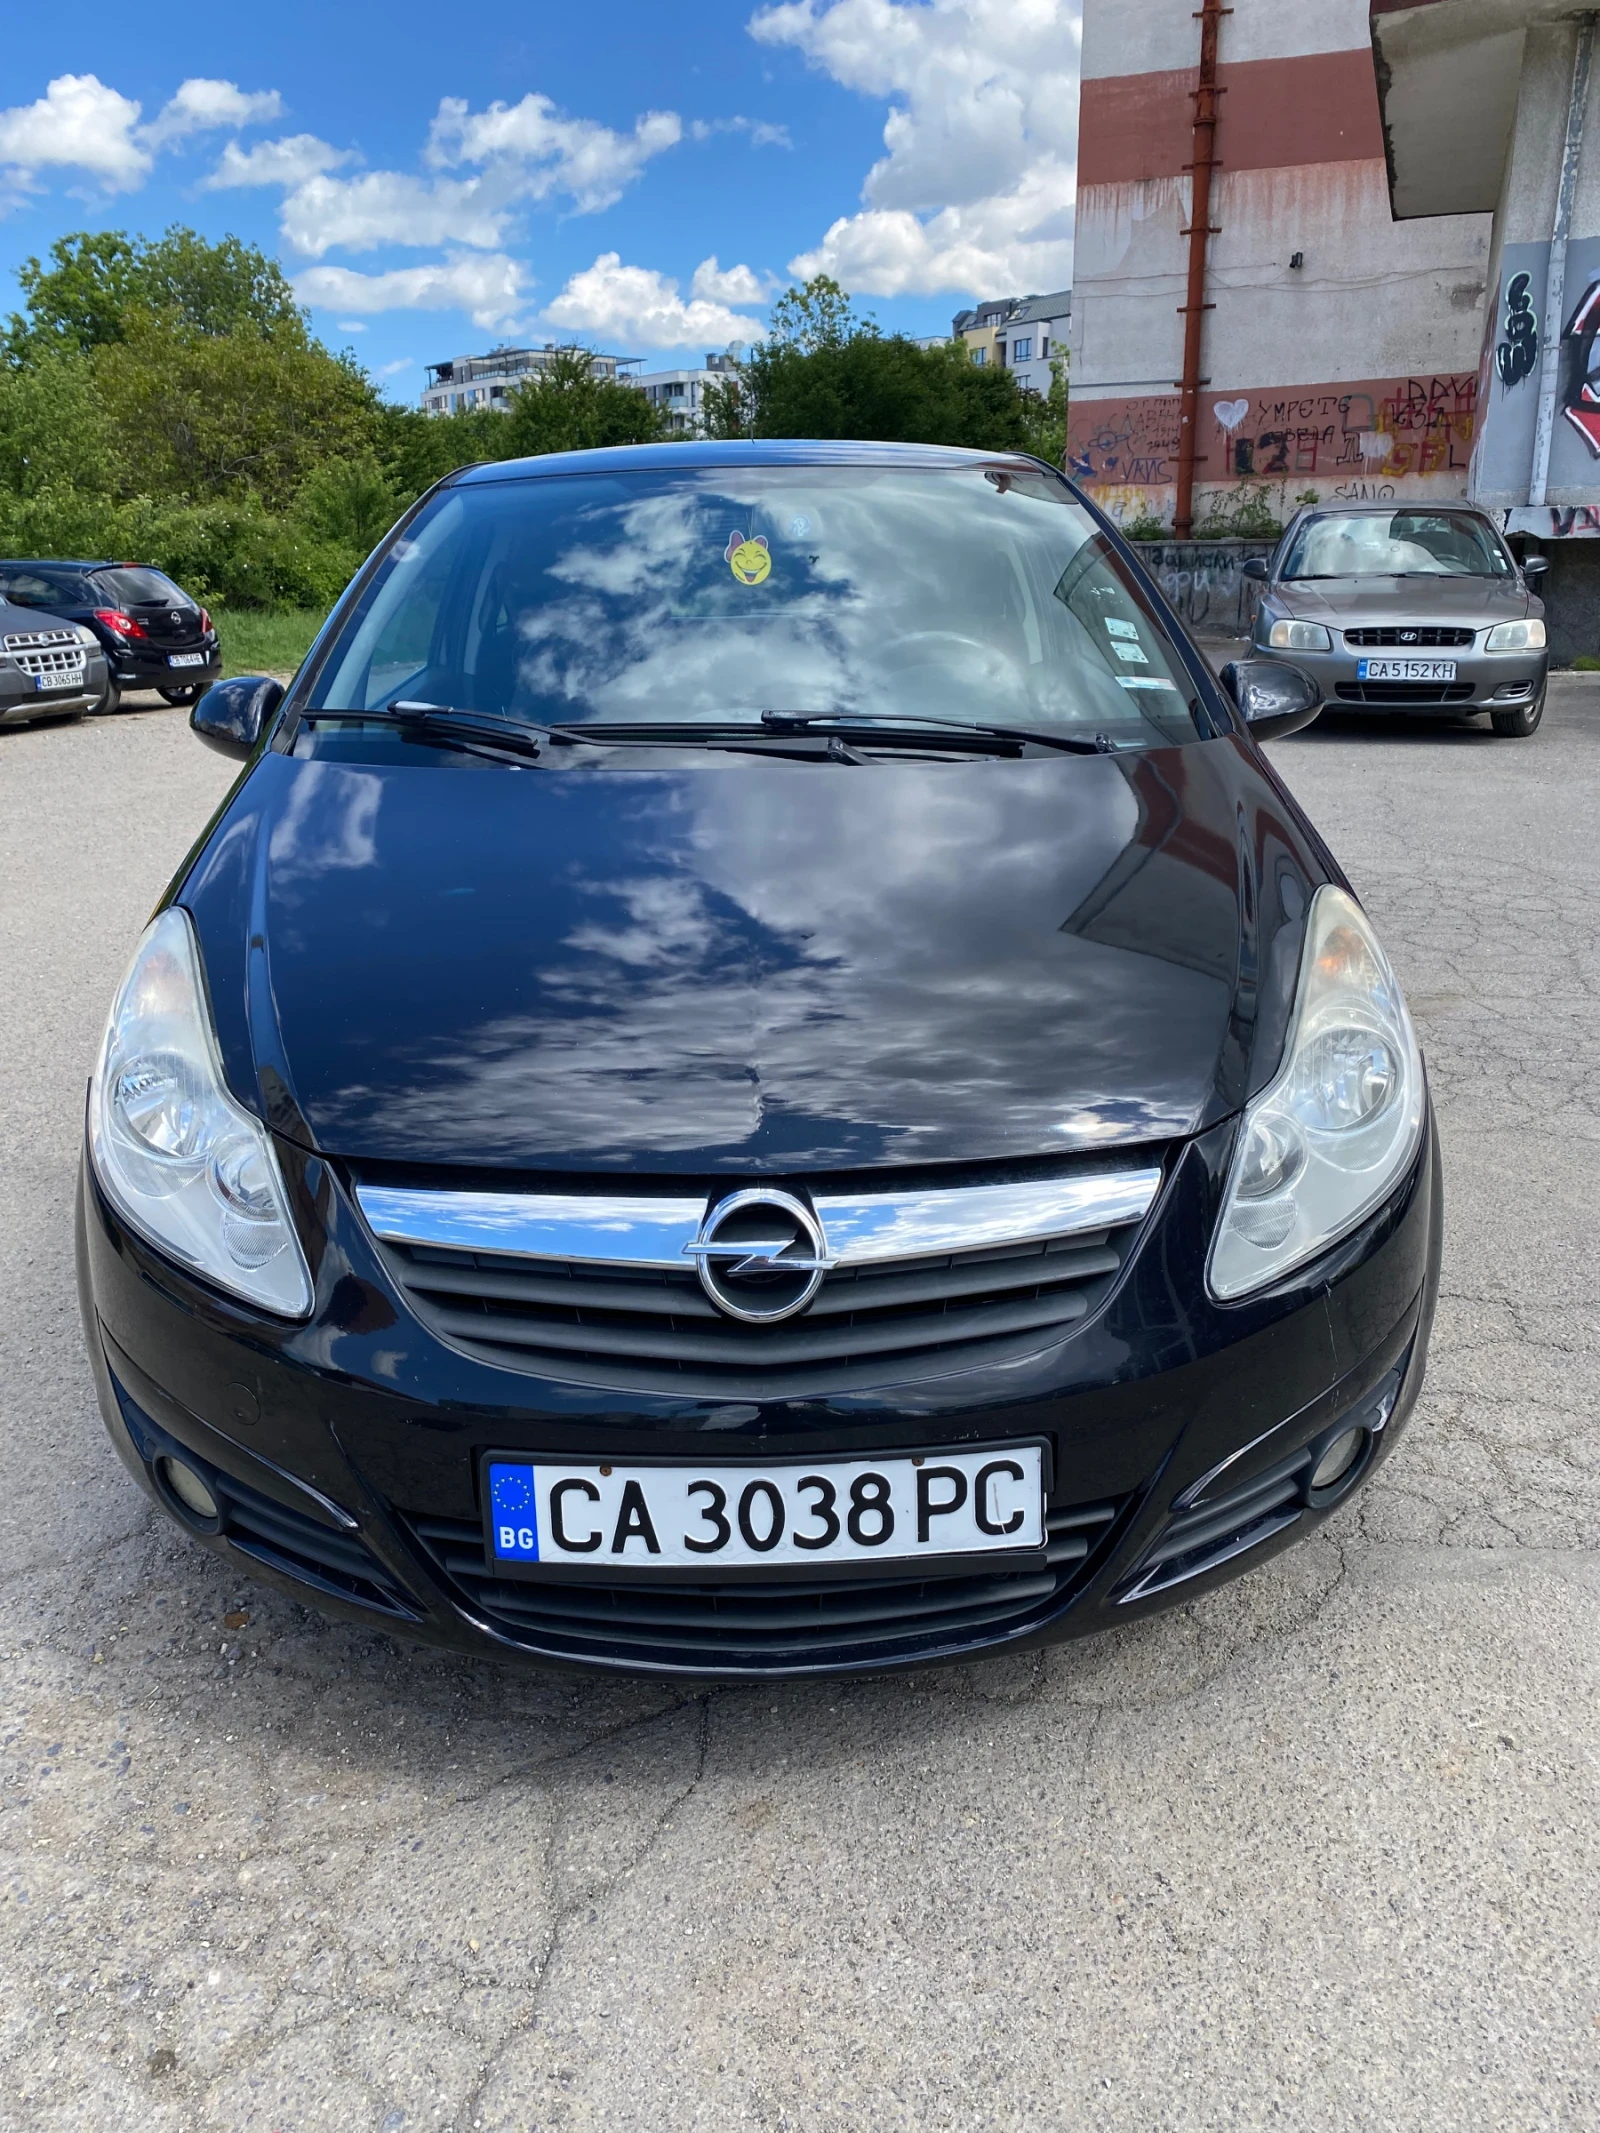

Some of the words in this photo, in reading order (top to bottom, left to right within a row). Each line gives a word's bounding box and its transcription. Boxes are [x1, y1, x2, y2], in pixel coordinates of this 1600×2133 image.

[1369, 662, 1388, 677] CA
[1391, 663, 1429, 677] 5152
[1432, 664, 1453, 678] KH
[42, 676, 53, 687] CB
[53, 674, 70, 686] 3065
[71, 672, 82, 684] HH
[500, 1526, 534, 1549] BG
[549, 1478, 661, 1554] CA
[684, 1472, 895, 1553] 3038
[916, 1460, 1025, 1542] PC
